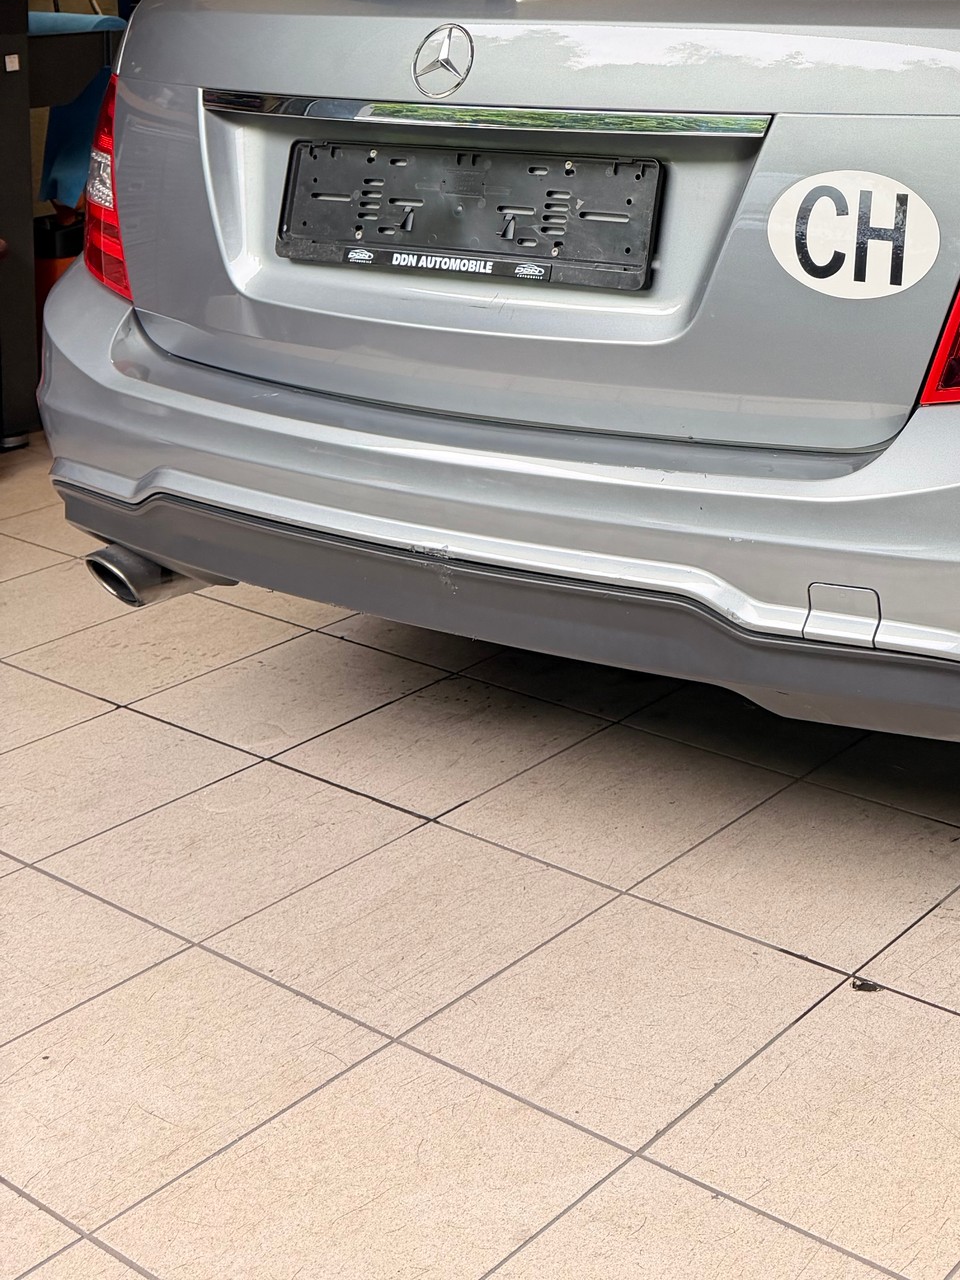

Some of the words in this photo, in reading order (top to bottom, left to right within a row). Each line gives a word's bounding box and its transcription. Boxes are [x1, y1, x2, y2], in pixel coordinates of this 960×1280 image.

[392, 253, 417, 266] DDN
[418, 255, 494, 274] AUTOMOBILE
[794, 184, 909, 286] CH
